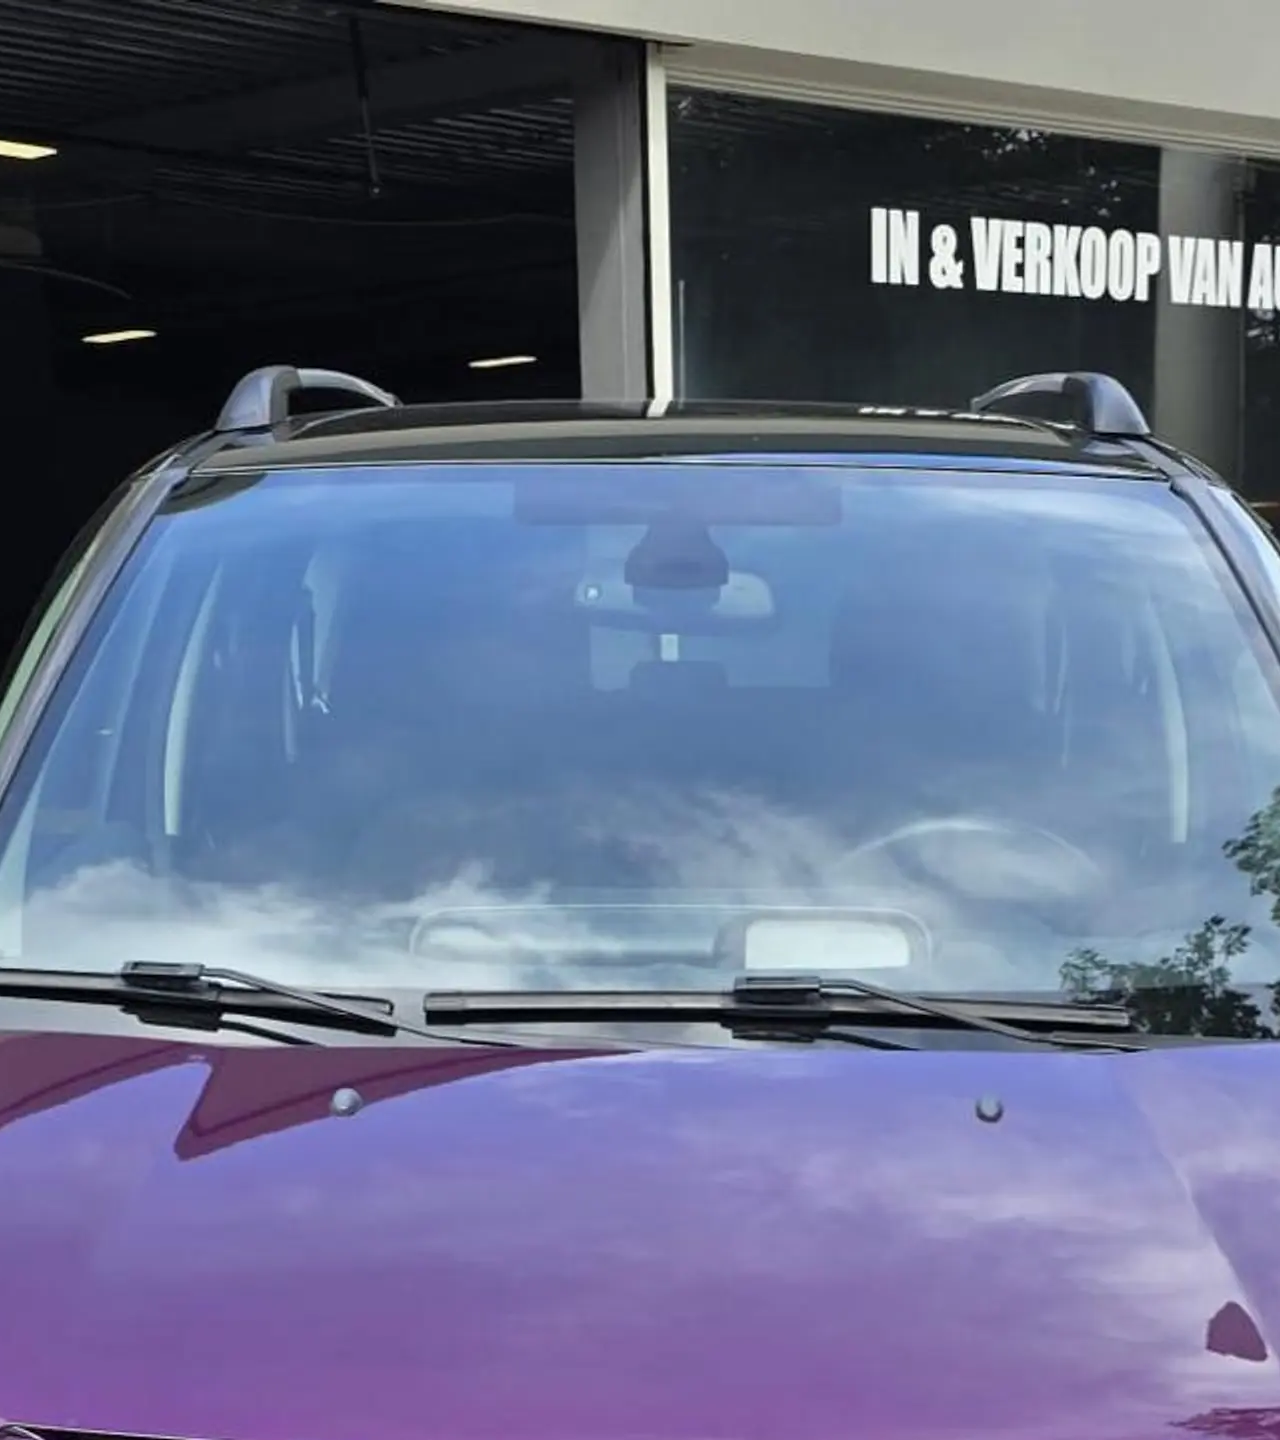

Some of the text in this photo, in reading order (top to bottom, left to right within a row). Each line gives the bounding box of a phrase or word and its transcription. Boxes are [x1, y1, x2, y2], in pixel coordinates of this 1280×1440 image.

[871, 206, 919, 285] IN
[929, 223, 963, 289] &
[971, 216, 1160, 302] VERKOOP
[1168, 235, 1243, 308] VAN
